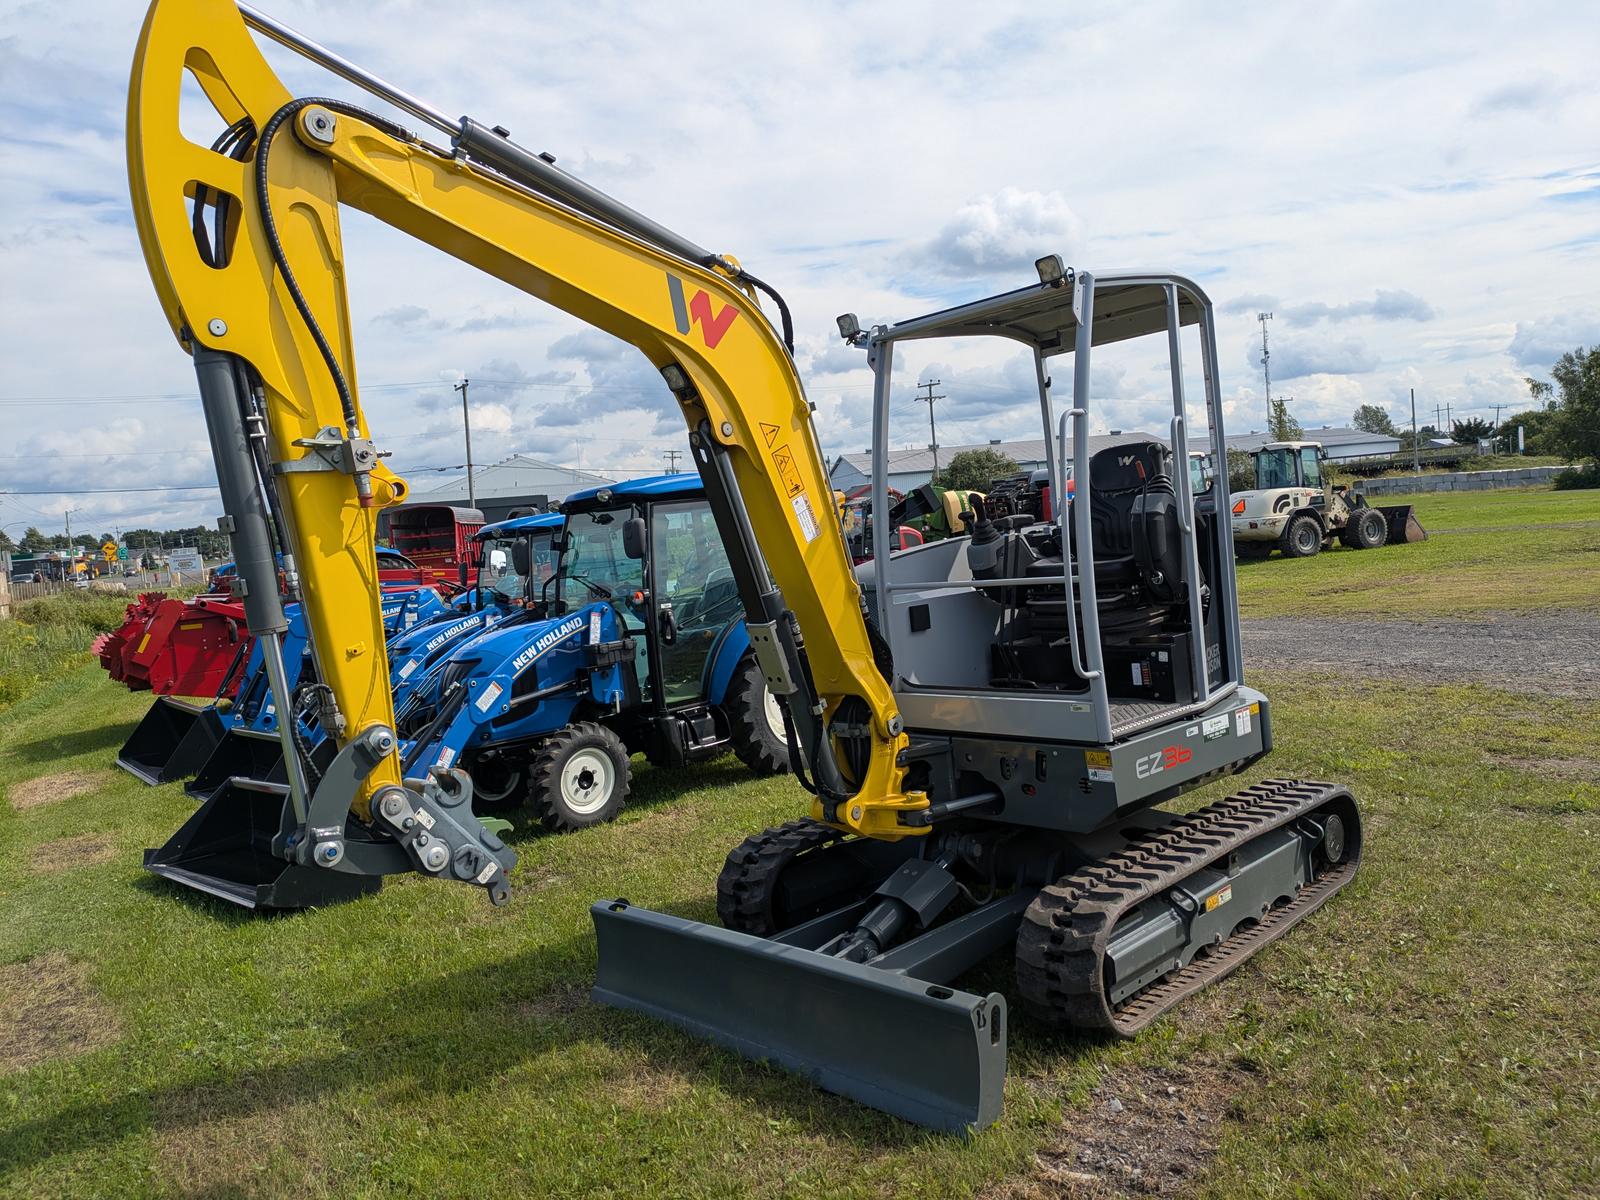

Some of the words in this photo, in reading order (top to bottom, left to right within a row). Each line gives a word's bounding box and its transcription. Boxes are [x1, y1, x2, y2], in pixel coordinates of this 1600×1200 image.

[426, 634, 445, 651] NEW
[445, 616, 480, 638] HOLLAND
[512, 645, 537, 670] NEW
[538, 617, 583, 650] HOLLAND
[1136, 745, 1193, 779] EZ36
